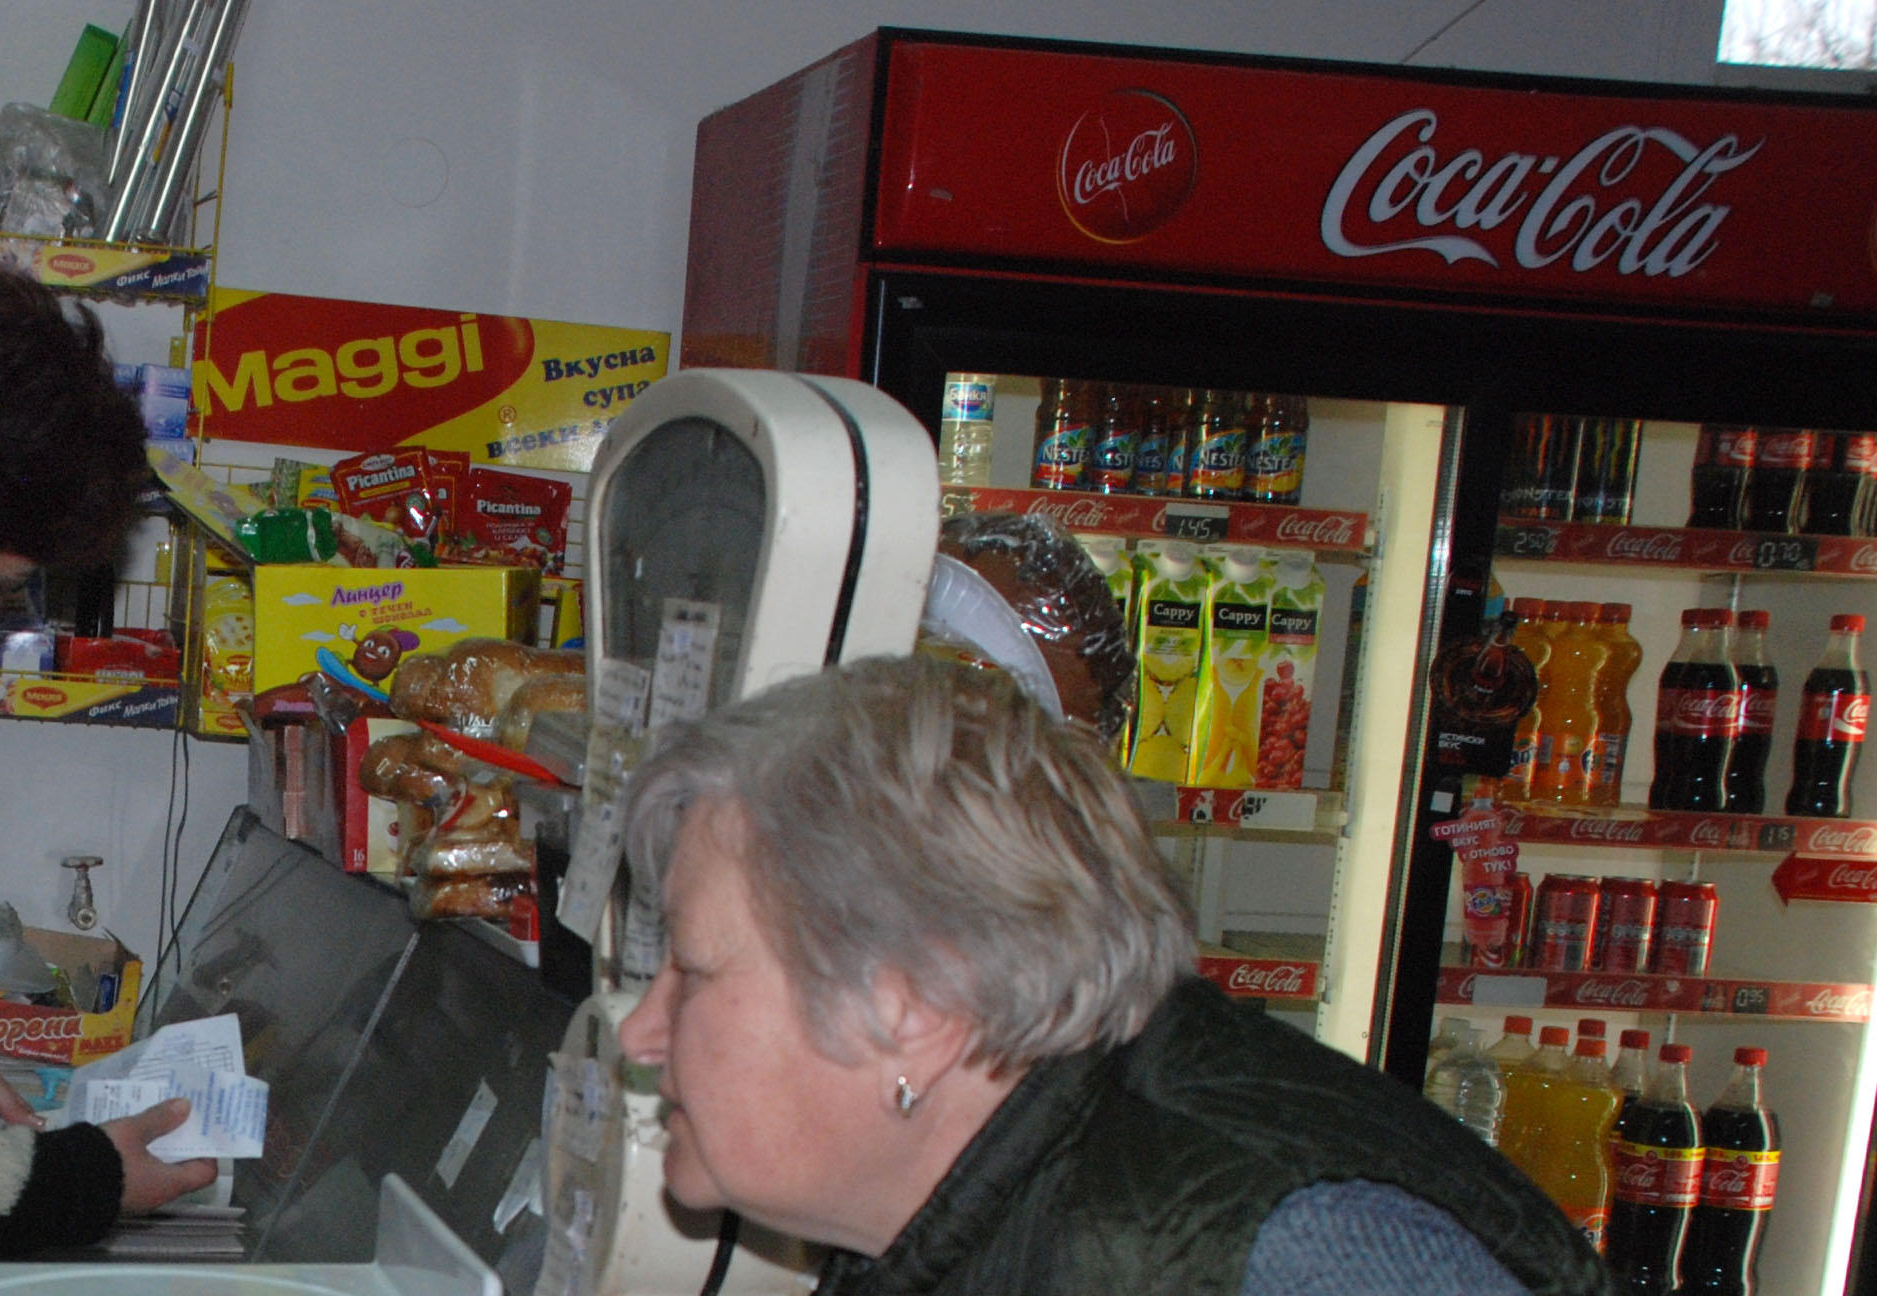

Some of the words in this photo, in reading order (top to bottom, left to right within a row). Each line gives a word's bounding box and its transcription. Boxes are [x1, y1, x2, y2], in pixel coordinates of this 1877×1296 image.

[191, 313, 485, 418] Maggi
[542, 345, 656, 383] Вкусна
[346, 464, 416, 491] Picantina
[477, 499, 542, 516] Picantina
[331, 581, 404, 607] Линцер
[1154, 603, 1197, 621] Cappy
[1219, 607, 1262, 625] Cappy
[1272, 613, 1312, 631] Cappy
[1483, 861, 1512, 874] ТУК!
